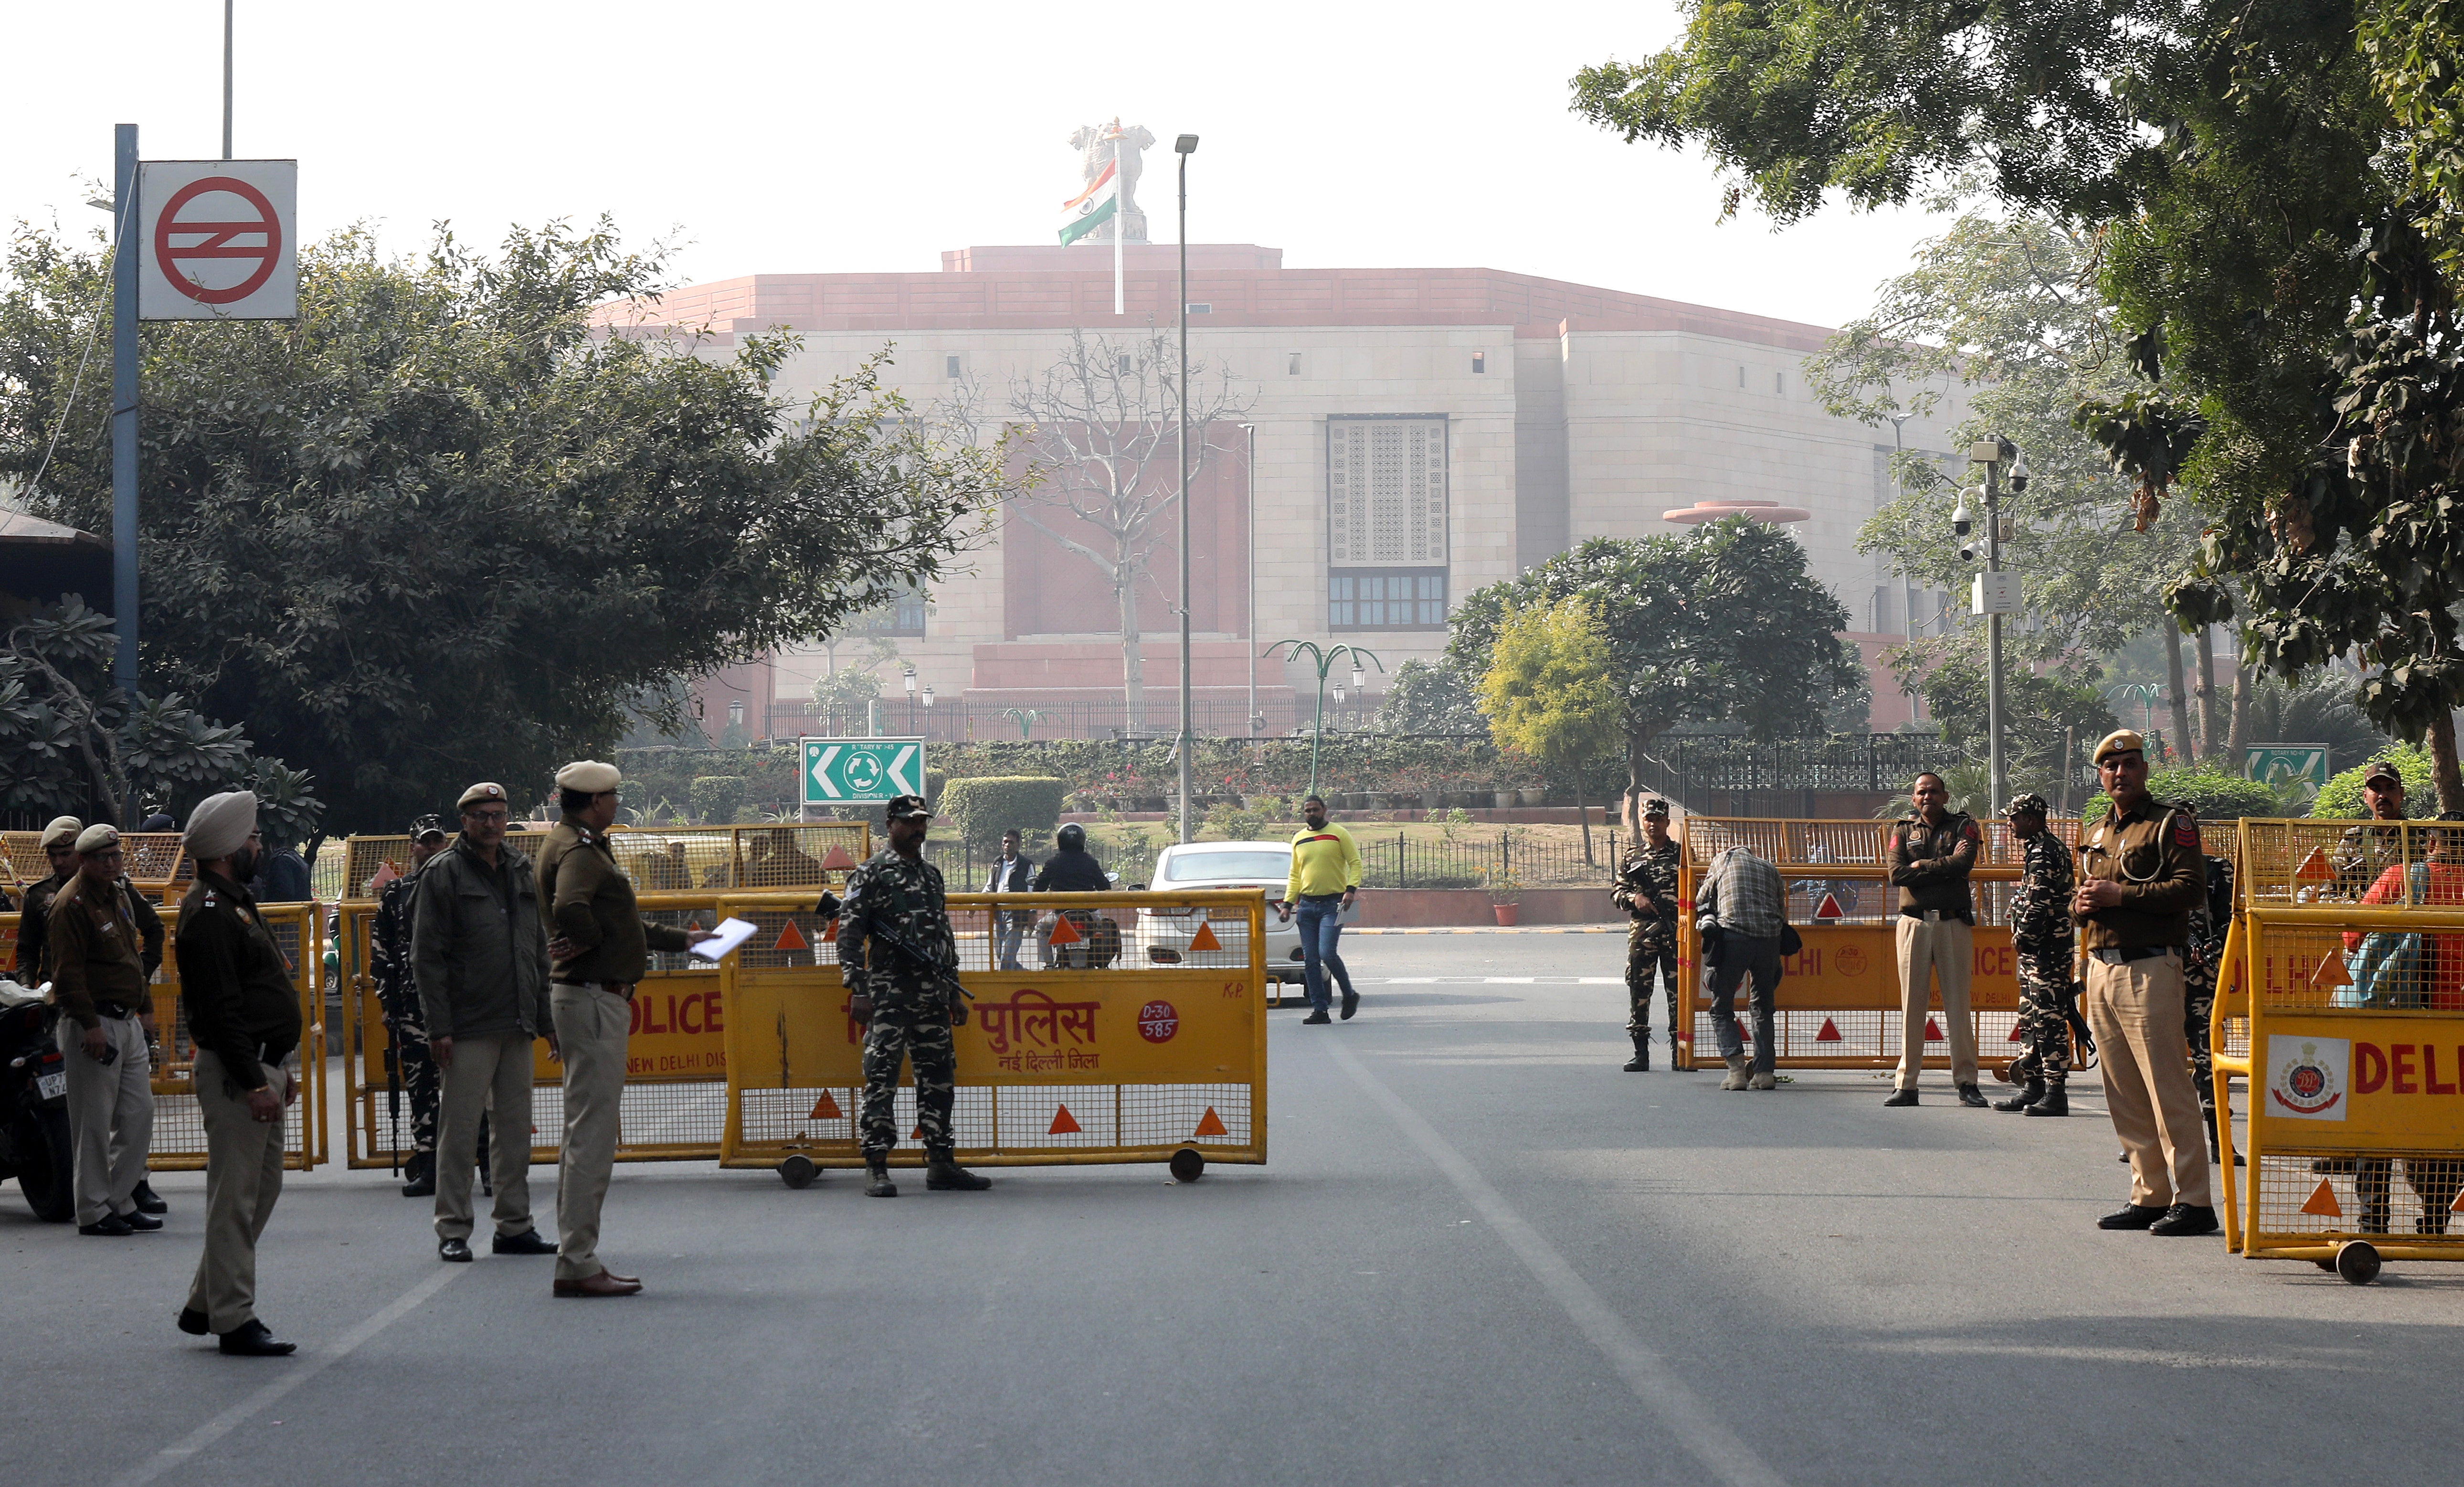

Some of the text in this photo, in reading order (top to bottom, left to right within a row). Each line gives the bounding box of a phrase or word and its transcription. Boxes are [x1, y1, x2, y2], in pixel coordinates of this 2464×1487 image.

[1784, 948, 1820, 976] LHI
[628, 991, 723, 1036] LICE
[973, 989, 1101, 1054] पुलिस
[1143, 1005, 1170, 1018] D-30
[1146, 1021, 1174, 1037] 585
[660, 1054, 700, 1071] DELHI
[706, 1052, 726, 1067] DIS
[998, 1048, 1100, 1073] नई दिल्ली जिला
[2355, 1042, 2464, 1095] DEL
